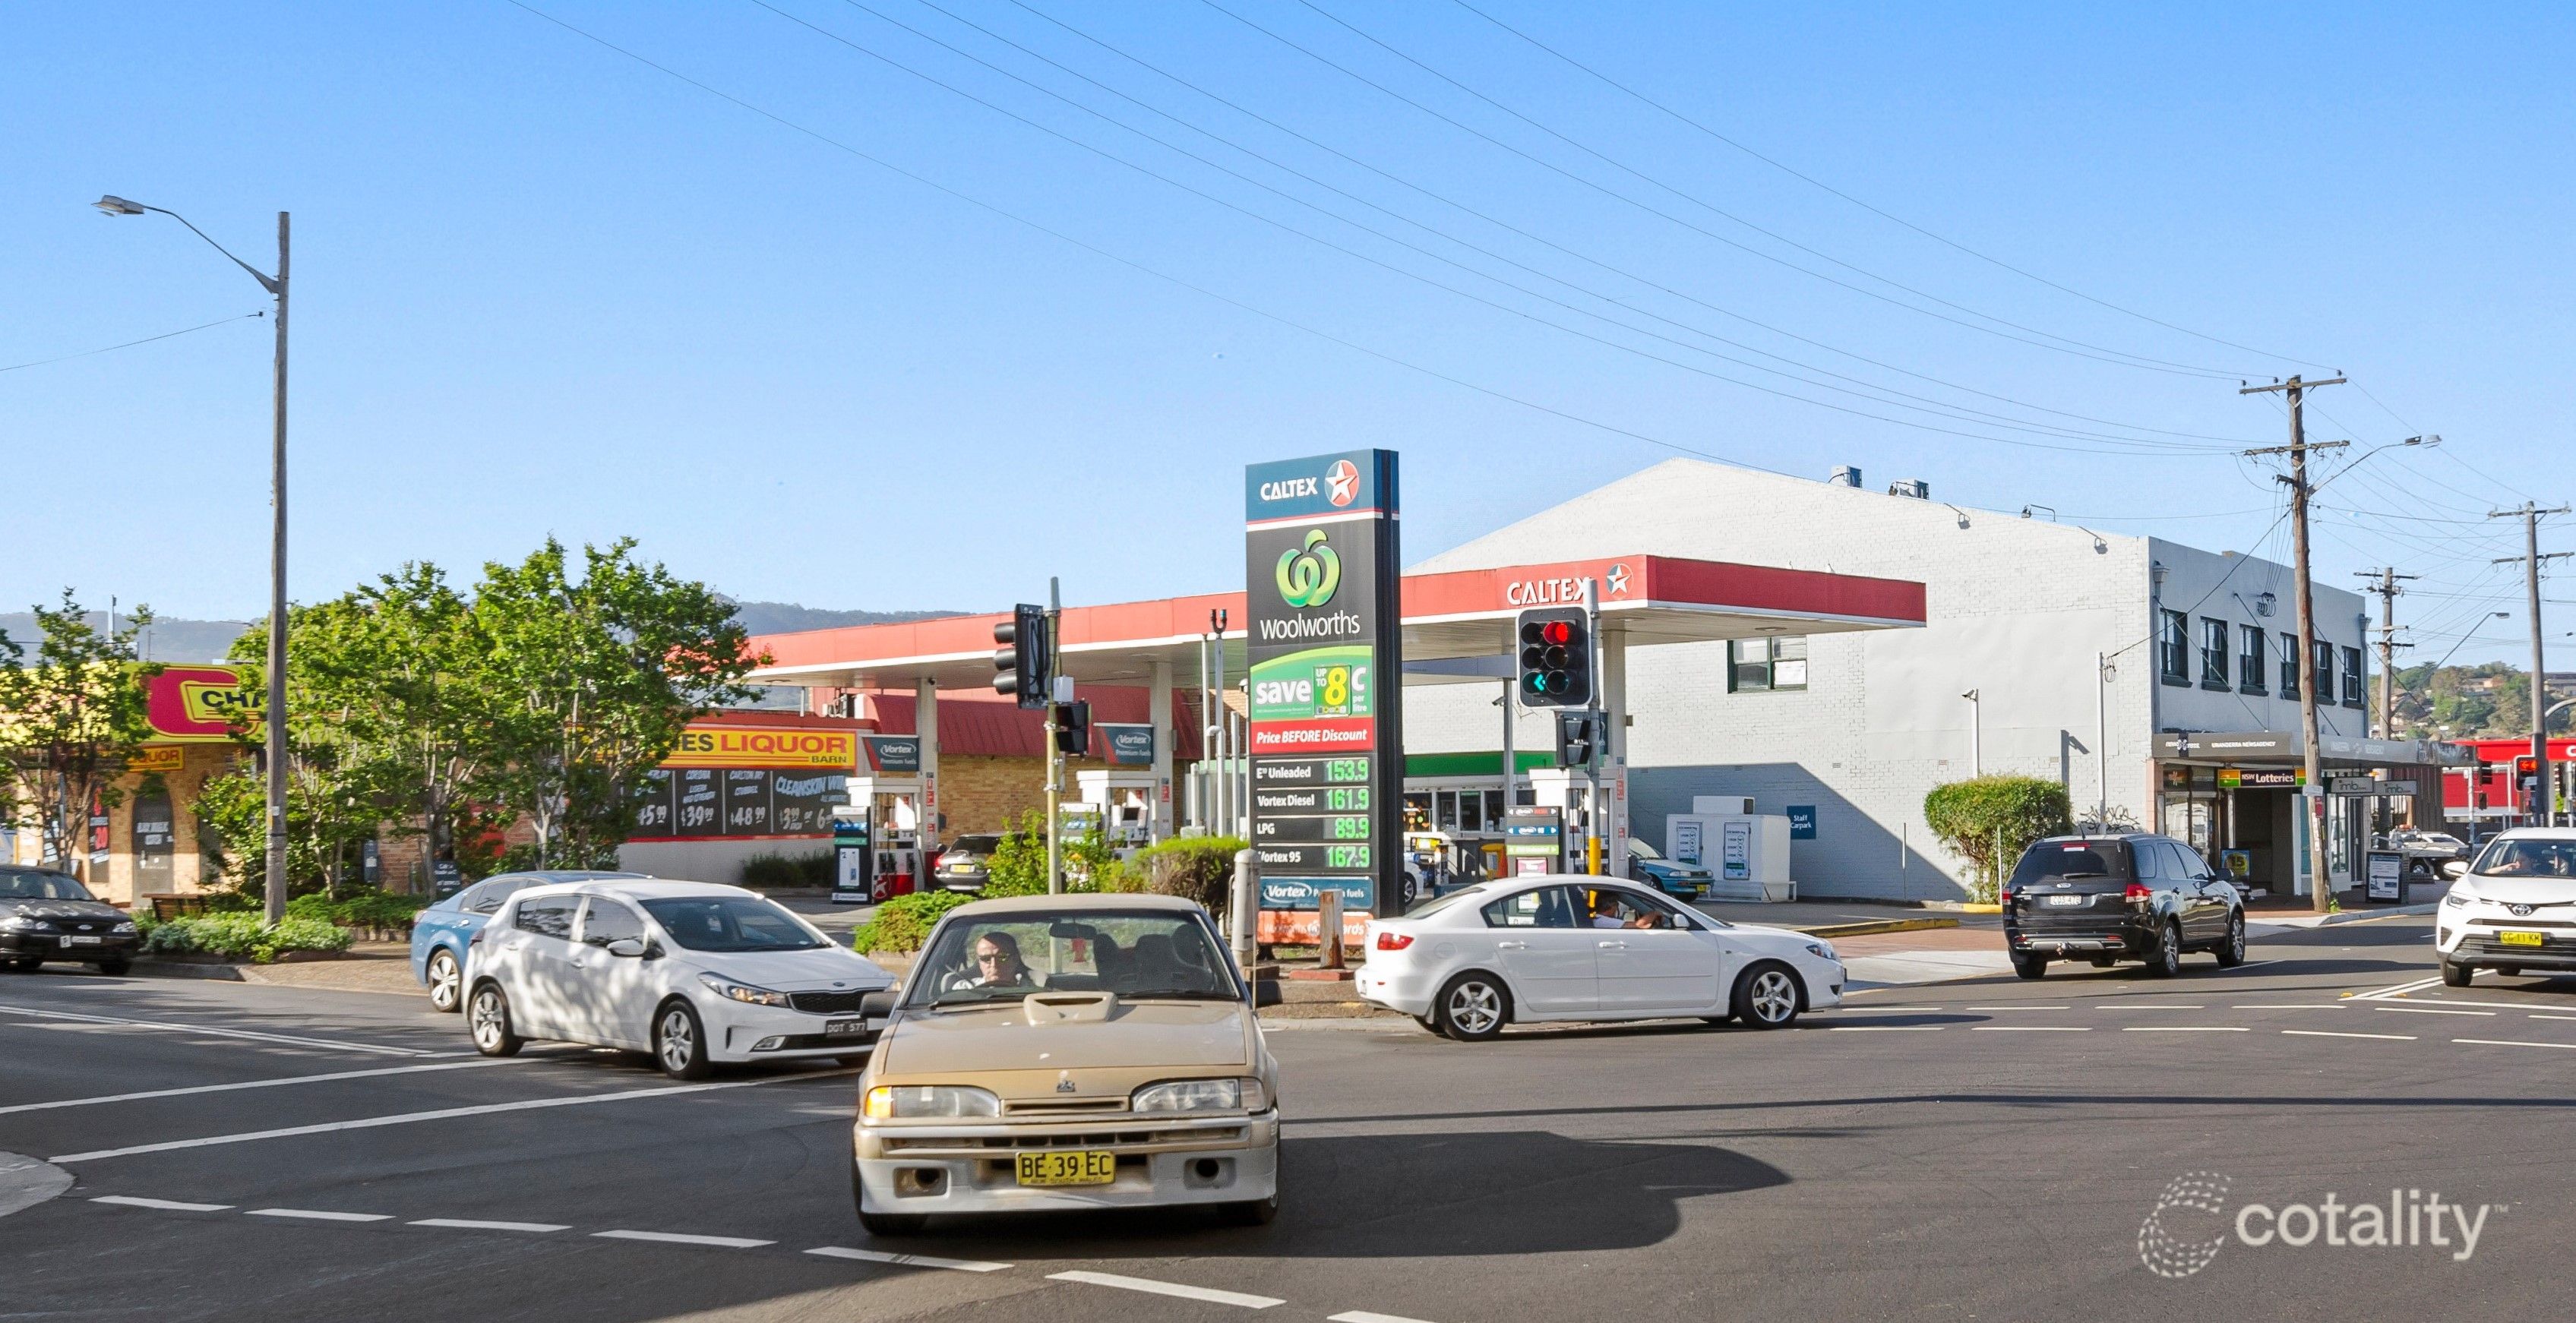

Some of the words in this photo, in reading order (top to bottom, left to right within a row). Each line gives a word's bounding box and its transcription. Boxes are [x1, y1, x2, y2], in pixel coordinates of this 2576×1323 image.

[1260, 476, 1319, 502] CALTEX
[1506, 576, 1592, 605] CALTEX
[1260, 609, 1361, 640] Woolworths
[1316, 668, 1327, 677] UP
[1316, 678, 1327, 687] TO
[1325, 667, 1348, 706] 8
[1255, 680, 1312, 705] save
[1118, 735, 1147, 744] Vortex
[1256, 732, 1281, 744] Price
[1282, 730, 1322, 744] BEFORE
[1322, 728, 1367, 742] Discount
[721, 734, 847, 753] LIQUOR
[1268, 766, 1311, 778] Unleaded
[1326, 760, 1368, 781] 153.9
[2255, 772, 2294, 784] Lotteries
[2339, 779, 2358, 790] imb
[2384, 783, 2404, 793] imb
[1257, 797, 1286, 807] Vortex
[1287, 794, 1315, 806] Diesel
[1326, 789, 1369, 810] 161.9
[1257, 823, 1275, 835] LPG
[1335, 818, 1369, 838] 89.9
[1791, 822, 1812, 830] Carpark
[1289, 851, 1301, 862] 95
[1327, 846, 1370, 867] 167.9
[1267, 885, 1306, 897] Vortex
[1346, 889, 1364, 898] fuels
[1054, 1156, 1078, 1176] 39
[1086, 1153, 1111, 1176] EC
